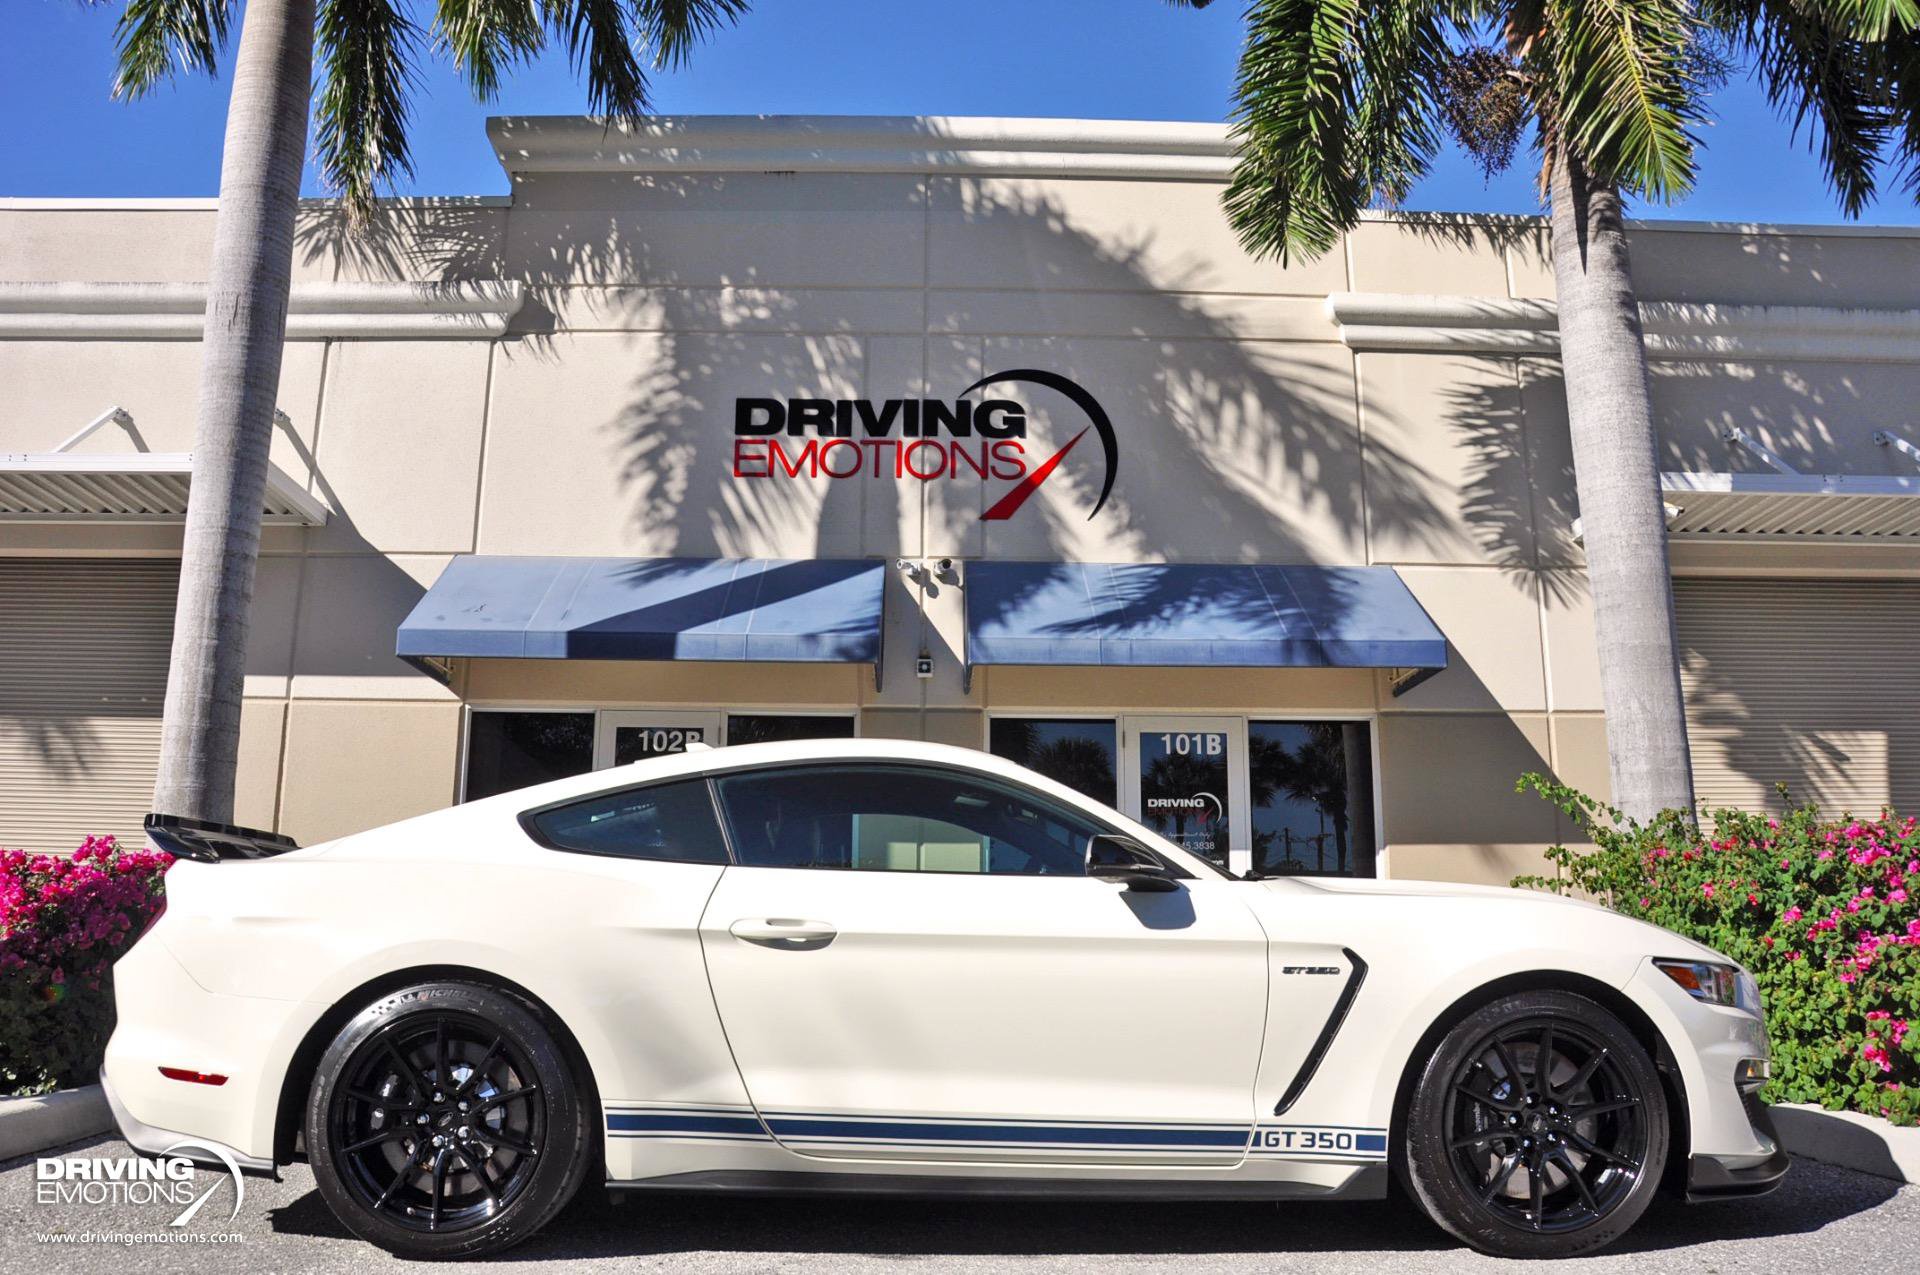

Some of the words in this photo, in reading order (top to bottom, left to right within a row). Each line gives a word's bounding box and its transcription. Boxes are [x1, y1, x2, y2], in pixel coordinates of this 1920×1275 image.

[735, 398, 1027, 438] DRIVING
[733, 439, 1027, 480] EMOTIONS
[1161, 734, 1222, 755] 101B
[1147, 798, 1205, 808] DRIVING
